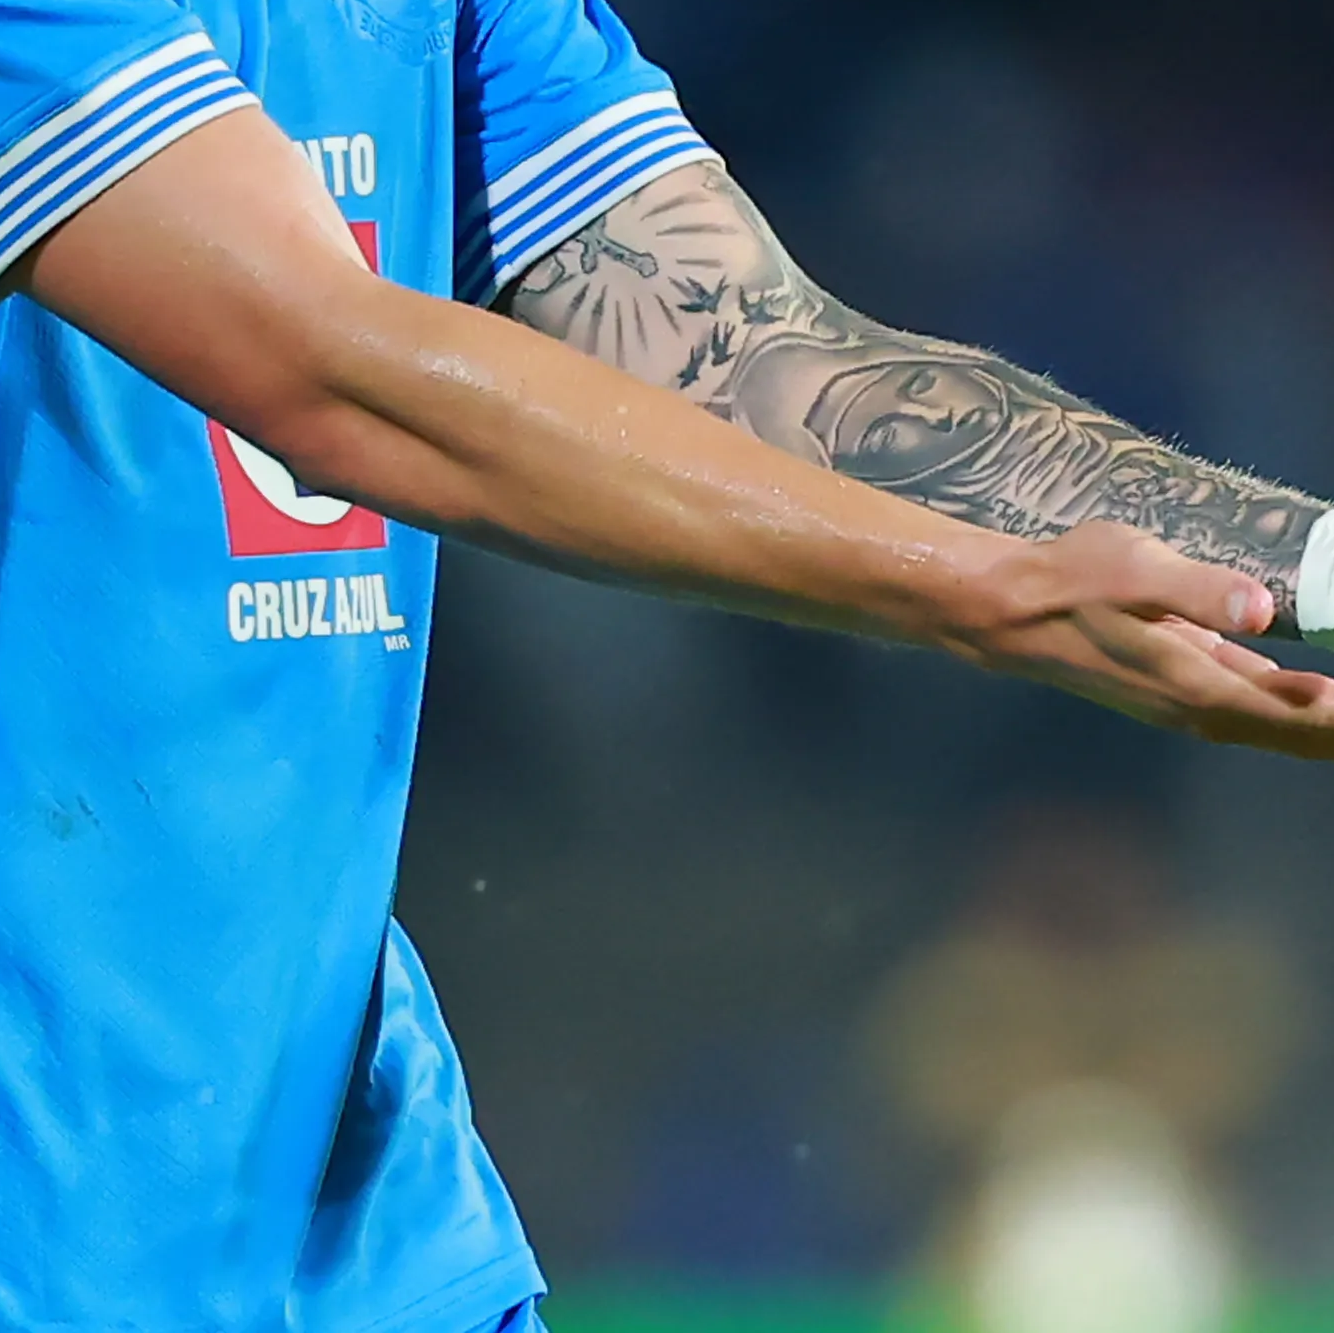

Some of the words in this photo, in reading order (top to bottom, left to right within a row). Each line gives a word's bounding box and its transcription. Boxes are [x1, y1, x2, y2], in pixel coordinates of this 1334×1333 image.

[228, 578, 332, 643] CRUZ
[334, 573, 405, 635] AZUL
[383, 633, 412, 652] MR
